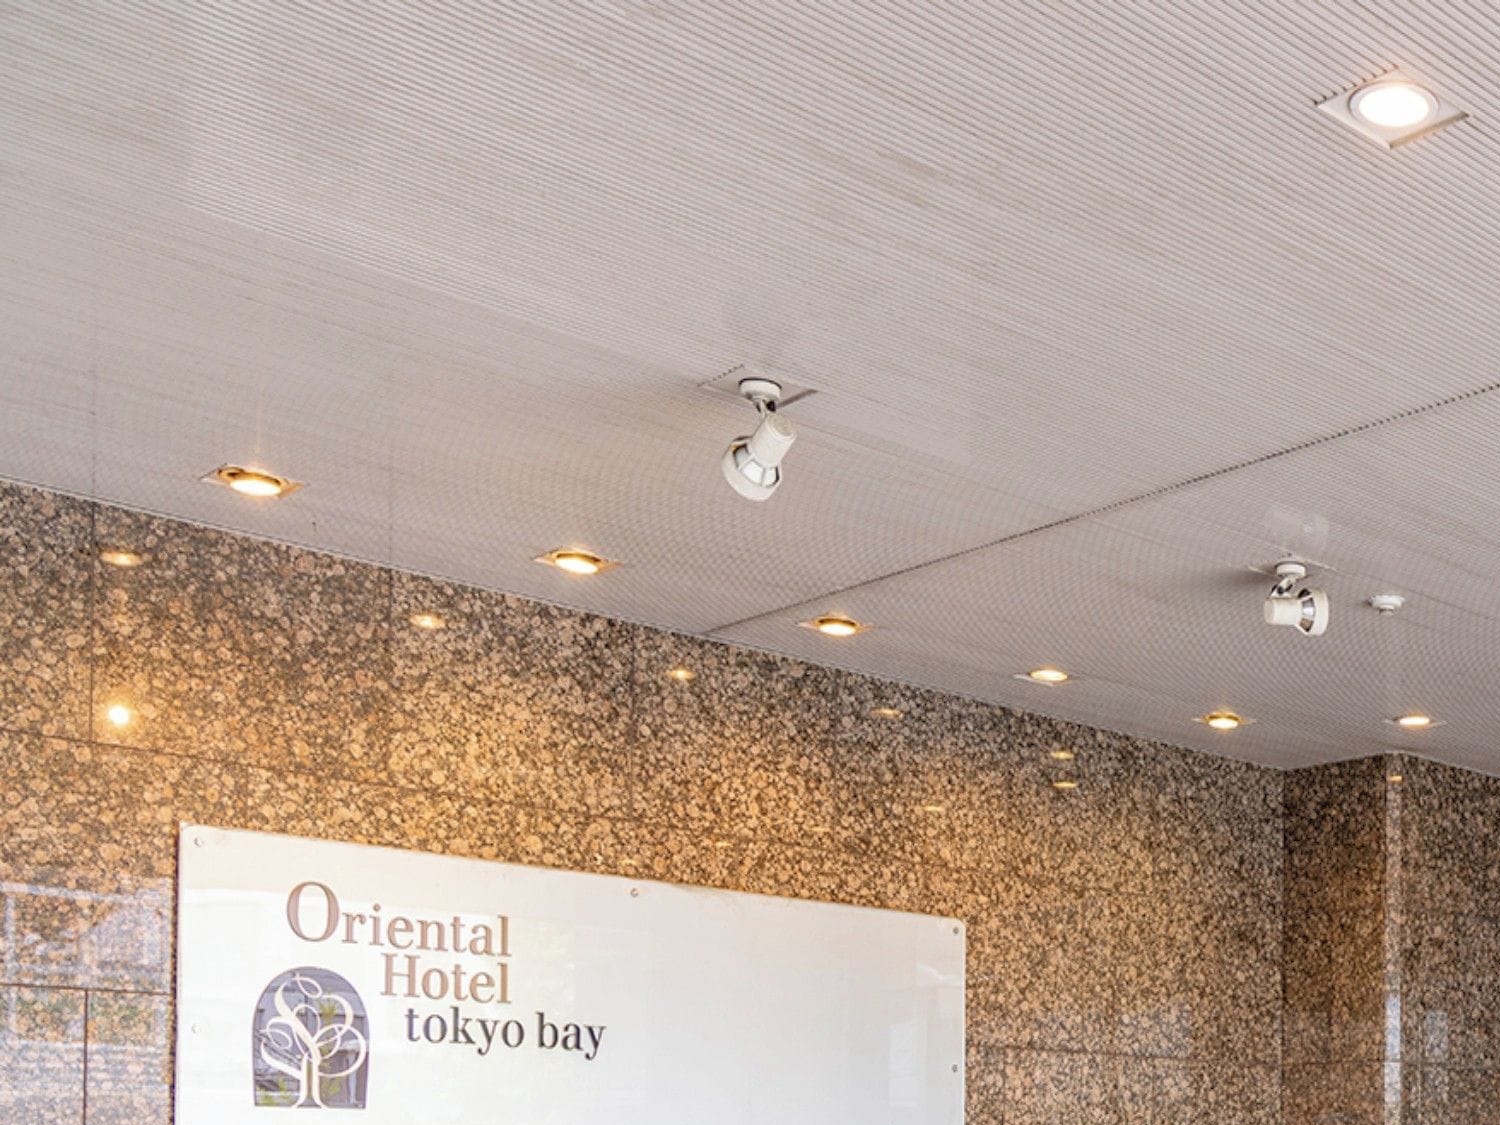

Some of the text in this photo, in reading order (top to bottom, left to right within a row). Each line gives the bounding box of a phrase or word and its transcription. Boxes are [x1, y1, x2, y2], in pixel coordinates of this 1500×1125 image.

[287, 881, 512, 957] Oriental
[379, 952, 512, 1004] Hotel
[405, 1006, 606, 1060] tokyo bay
